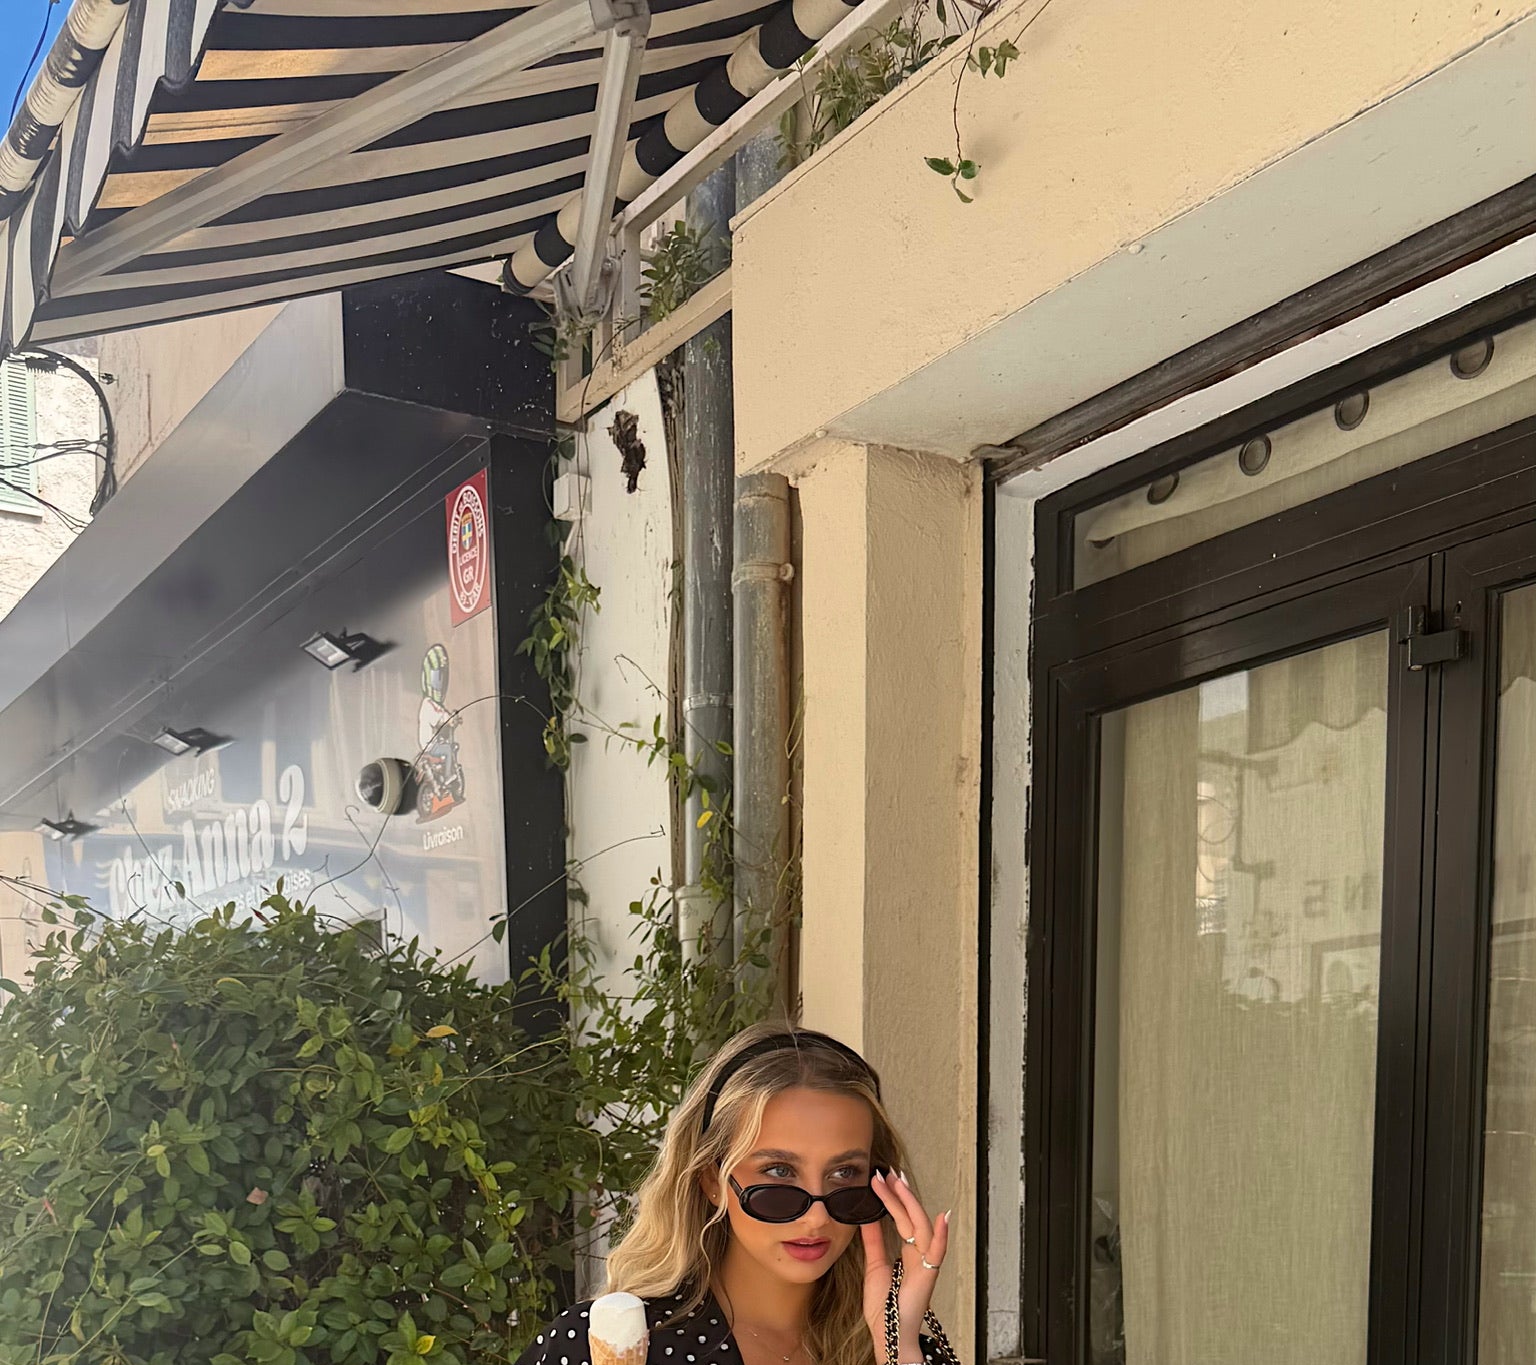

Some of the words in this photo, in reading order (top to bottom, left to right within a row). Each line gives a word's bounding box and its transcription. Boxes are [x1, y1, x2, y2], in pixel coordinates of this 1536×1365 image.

[168, 768, 215, 811] SNACKING
[183, 800, 275, 898] Anna
[280, 765, 308, 861] 2
[423, 825, 464, 850] Livraison
